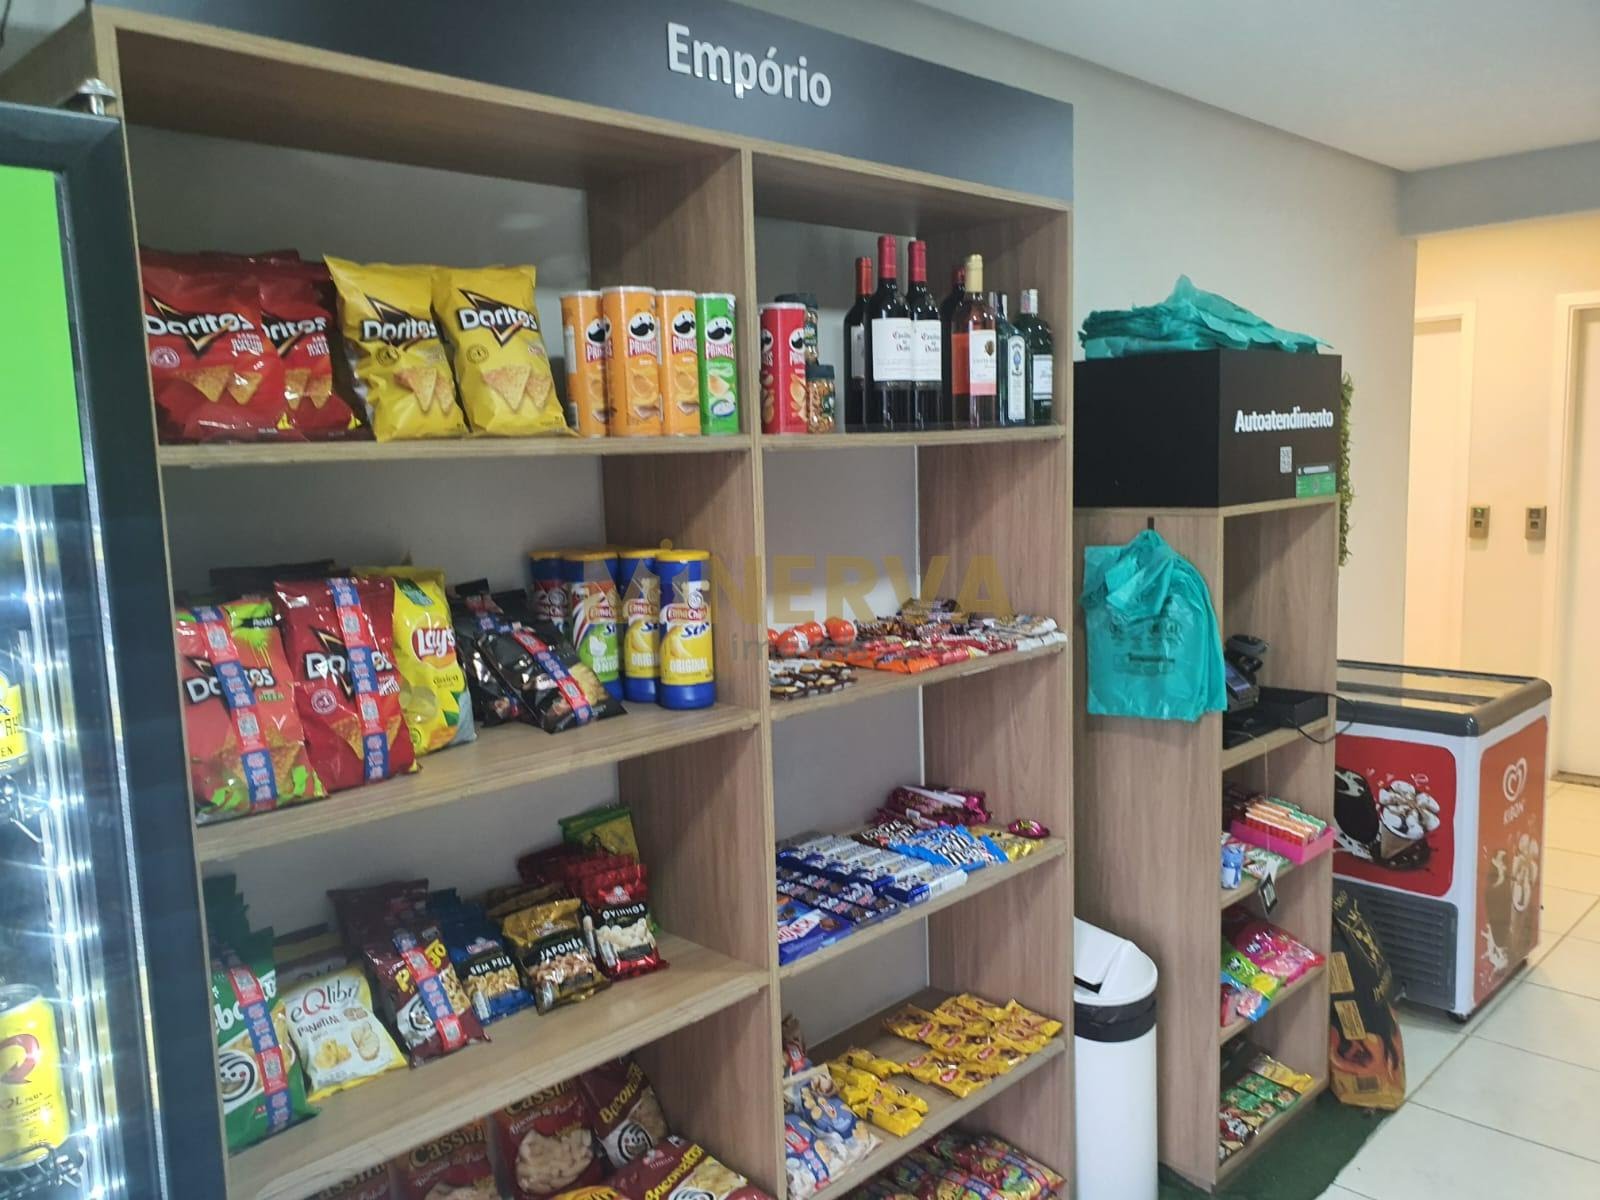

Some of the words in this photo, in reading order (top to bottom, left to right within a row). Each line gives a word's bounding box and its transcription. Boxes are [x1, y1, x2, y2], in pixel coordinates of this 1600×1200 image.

[667, 22, 832, 107] Empório
[363, 319, 438, 342] Doritos
[459, 306, 538, 331] Doritos
[1234, 405, 1334, 433] Autoatendimento
[416, 628, 456, 658] Lay's
[602, 903, 646, 920] OVINHOS
